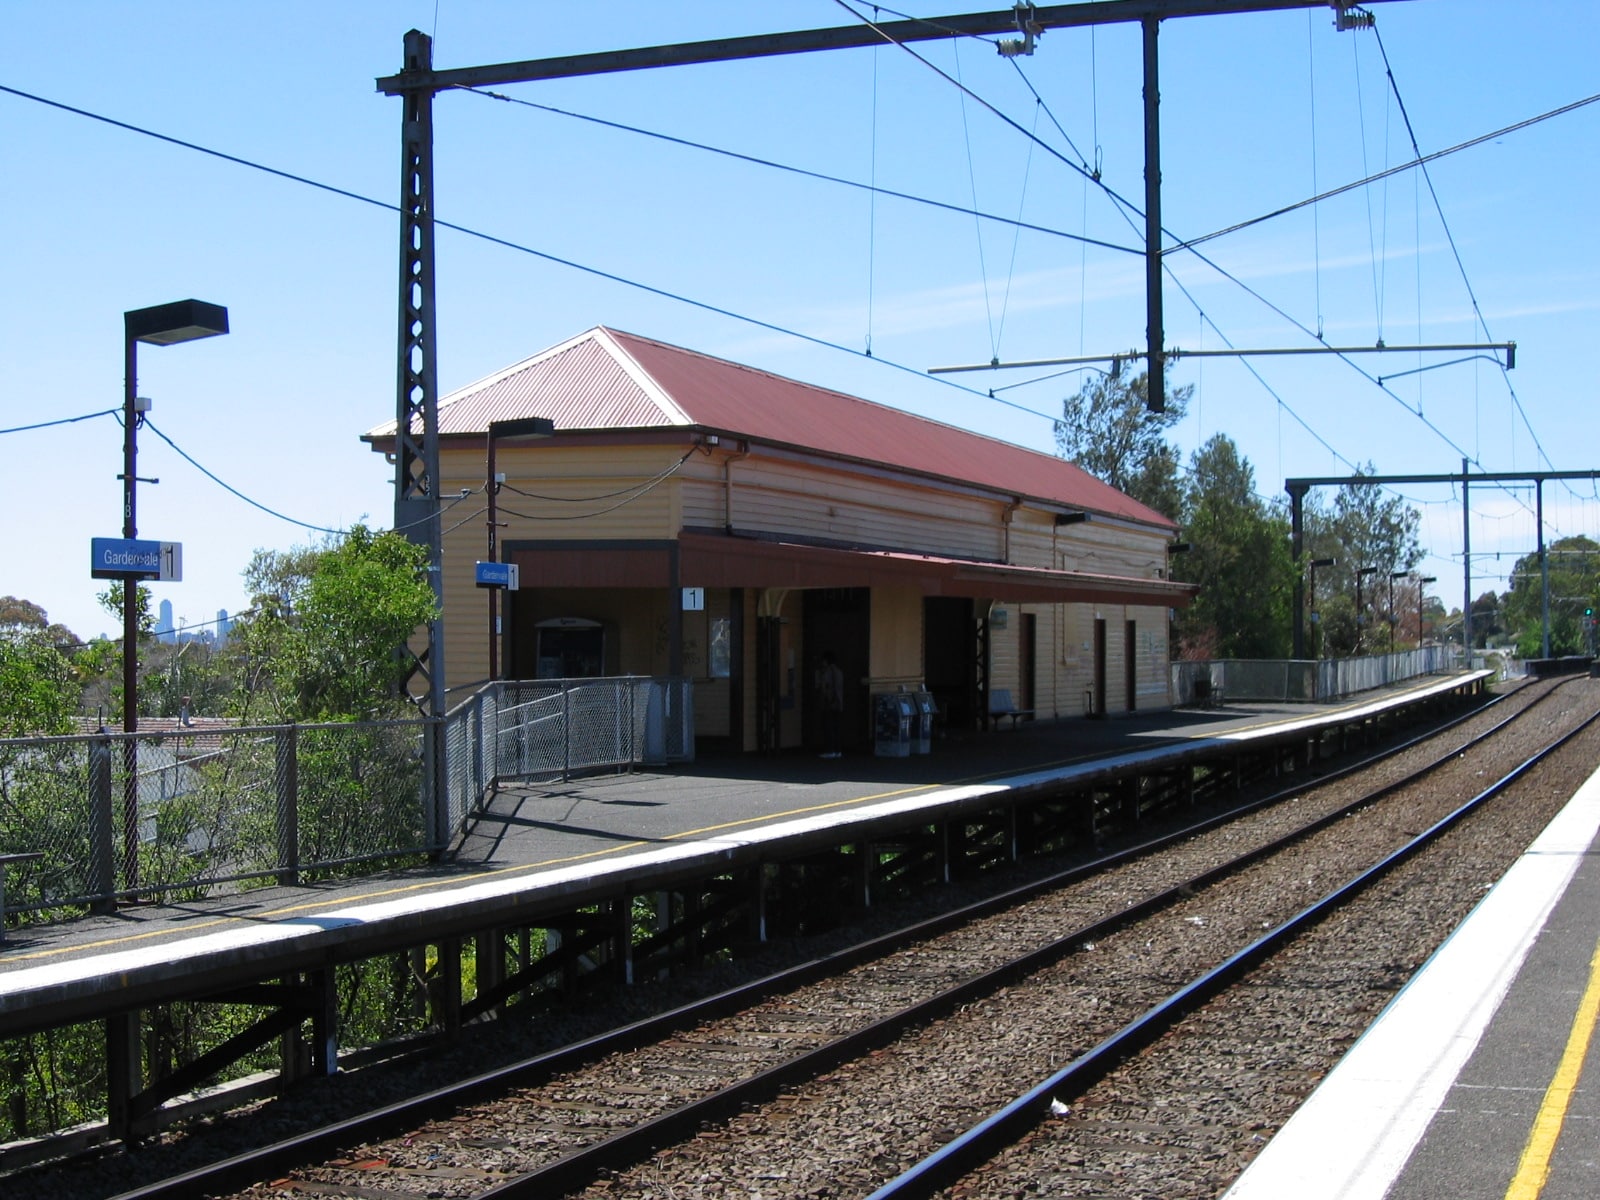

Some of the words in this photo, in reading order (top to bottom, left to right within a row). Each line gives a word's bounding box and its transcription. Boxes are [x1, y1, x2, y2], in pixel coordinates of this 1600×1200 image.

[125, 492, 132, 518] 18
[165, 545, 174, 578] 1
[689, 589, 696, 609] 1
